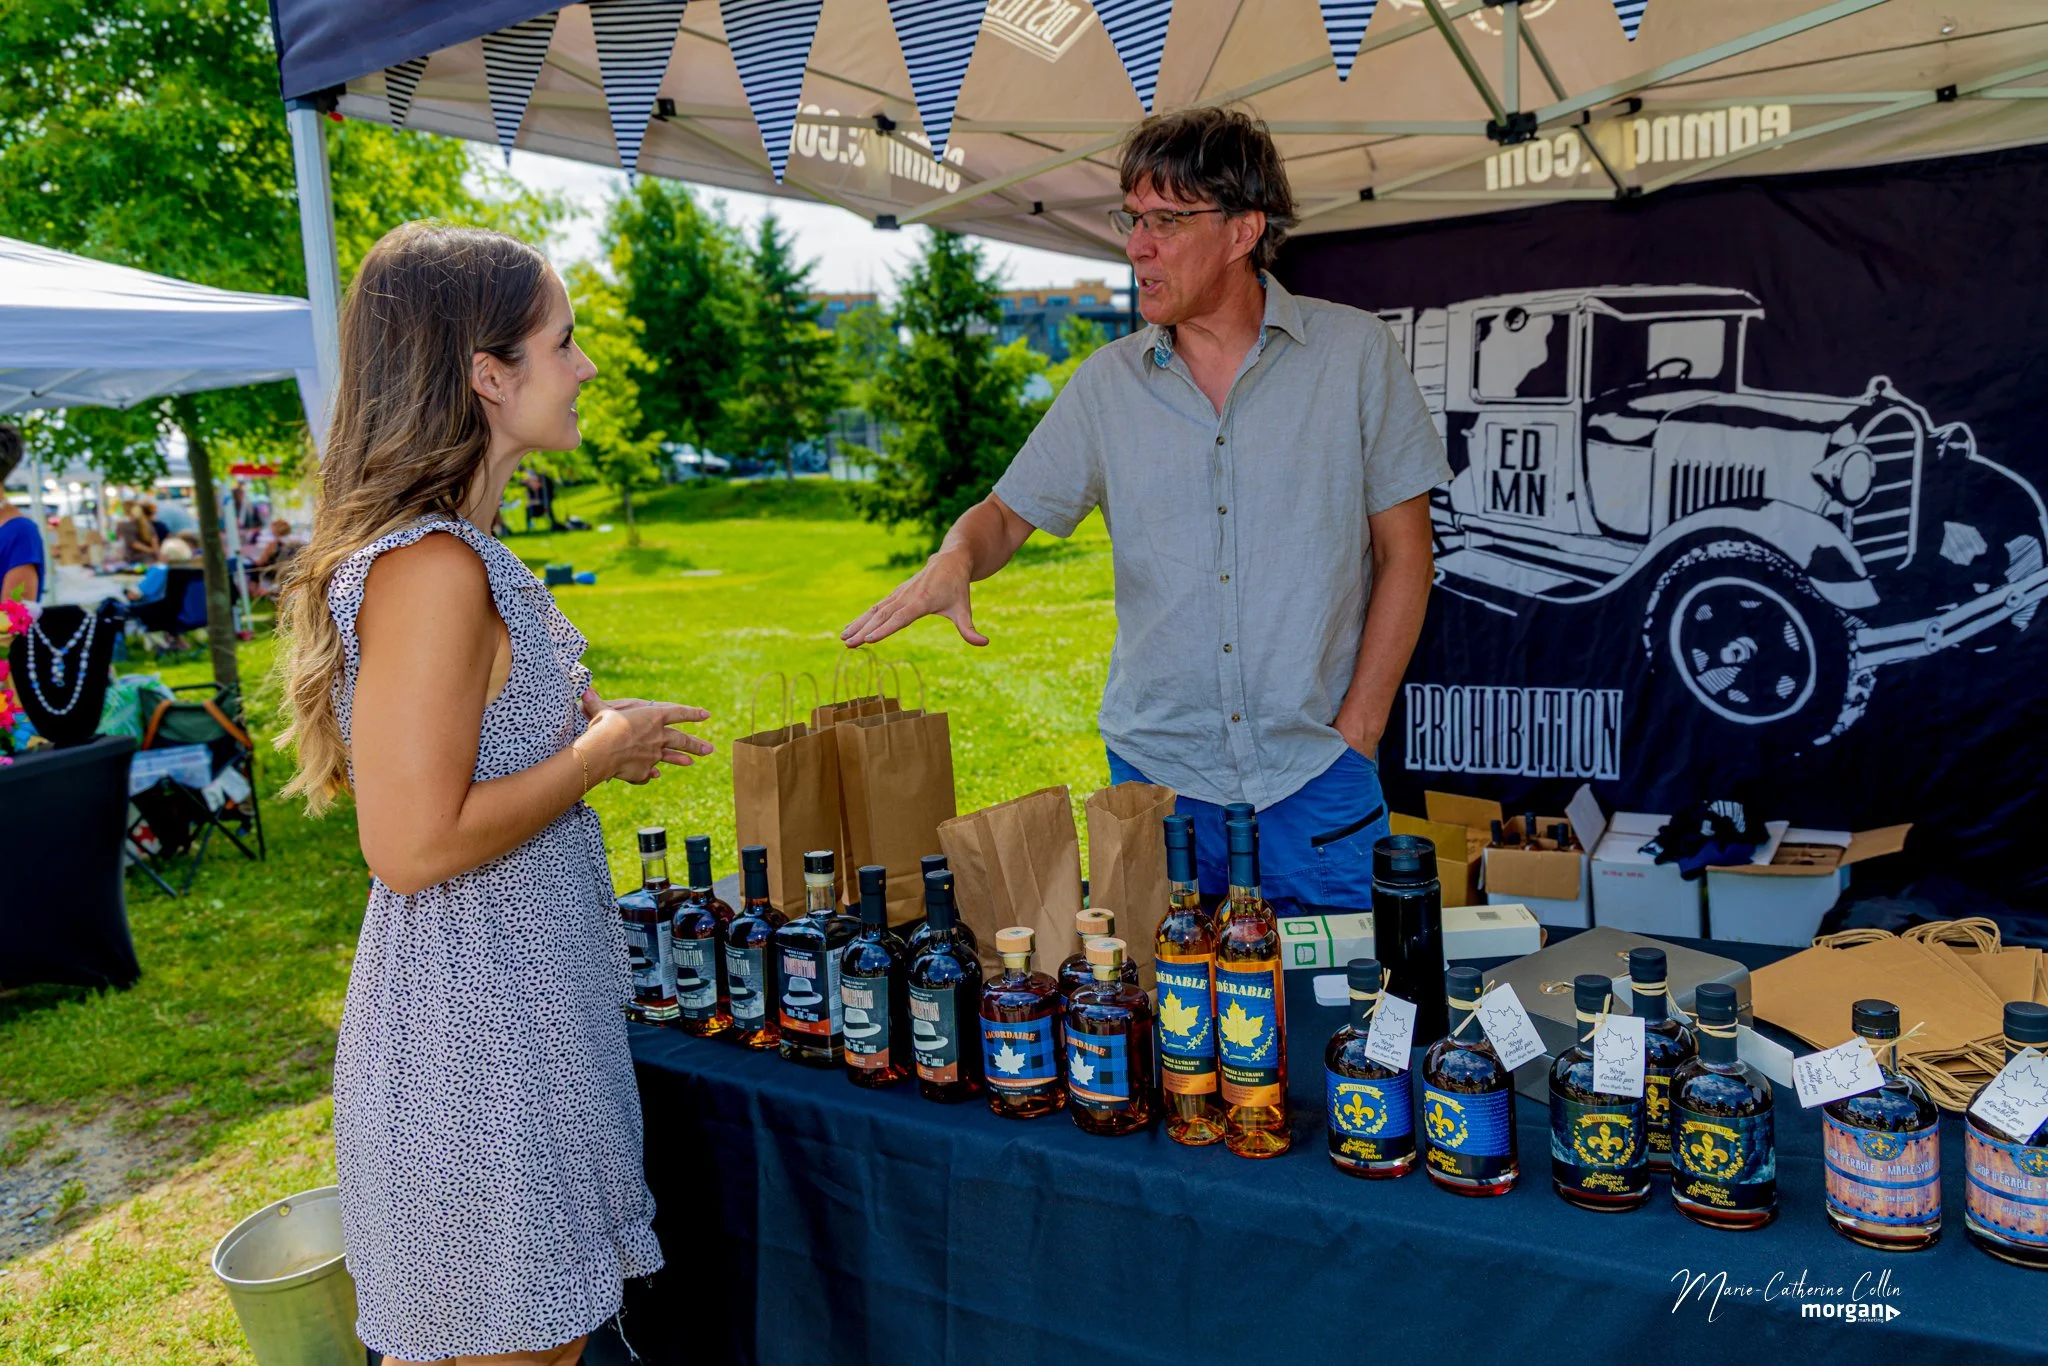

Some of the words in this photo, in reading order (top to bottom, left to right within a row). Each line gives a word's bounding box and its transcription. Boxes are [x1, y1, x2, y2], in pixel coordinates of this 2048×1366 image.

[1500, 428, 1540, 471] ED
[1492, 469, 1546, 517] MN
[1405, 683, 1623, 780] PROHIBITION
[985, 1030, 1036, 1041] LACORDAIRE
[1888, 1164, 1916, 1176] MAPLE
